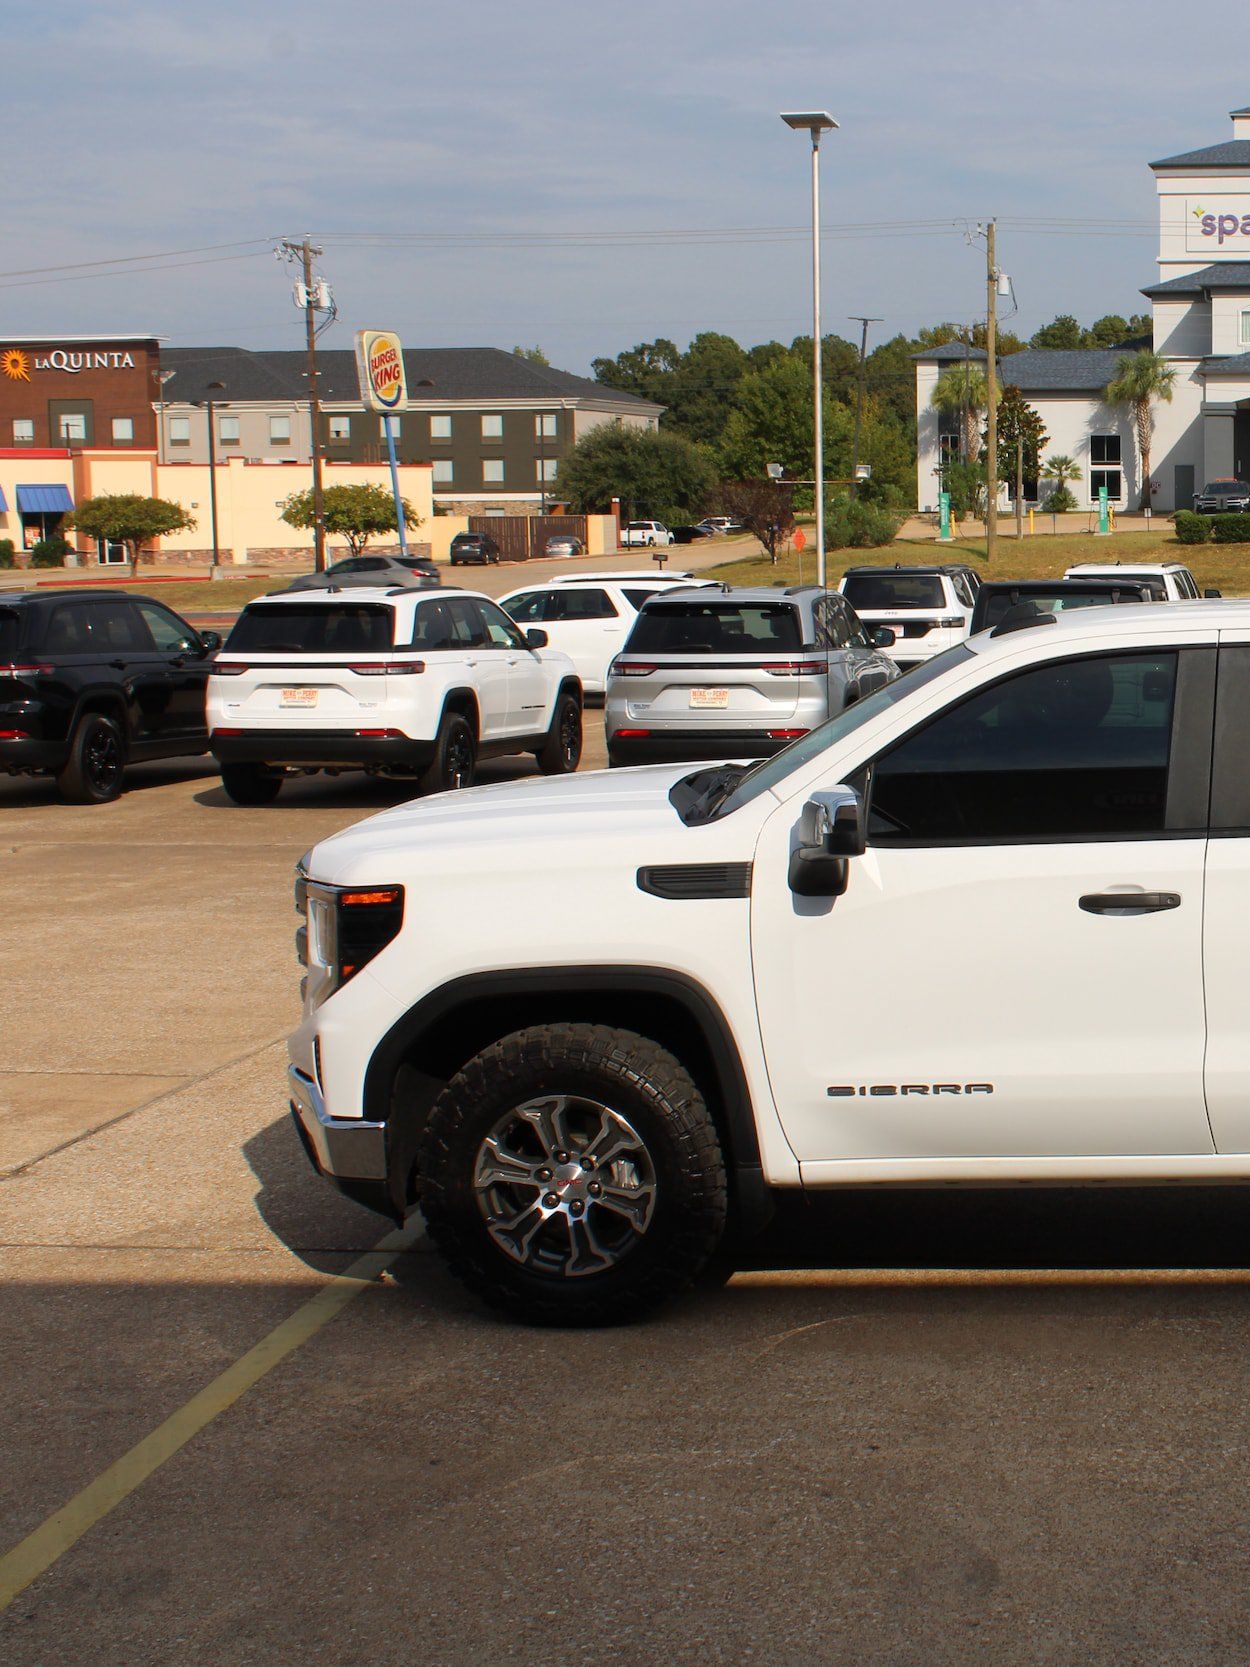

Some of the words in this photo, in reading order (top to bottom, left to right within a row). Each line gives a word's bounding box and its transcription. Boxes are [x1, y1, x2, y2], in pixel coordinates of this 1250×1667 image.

[35, 357, 50, 369] LA
[50, 349, 135, 373] QUINTA
[371, 348, 397, 372] BURGER
[373, 363, 400, 392] KING
[827, 1083, 994, 1097] SIERRA
[557, 1179, 583, 1187] GMC
